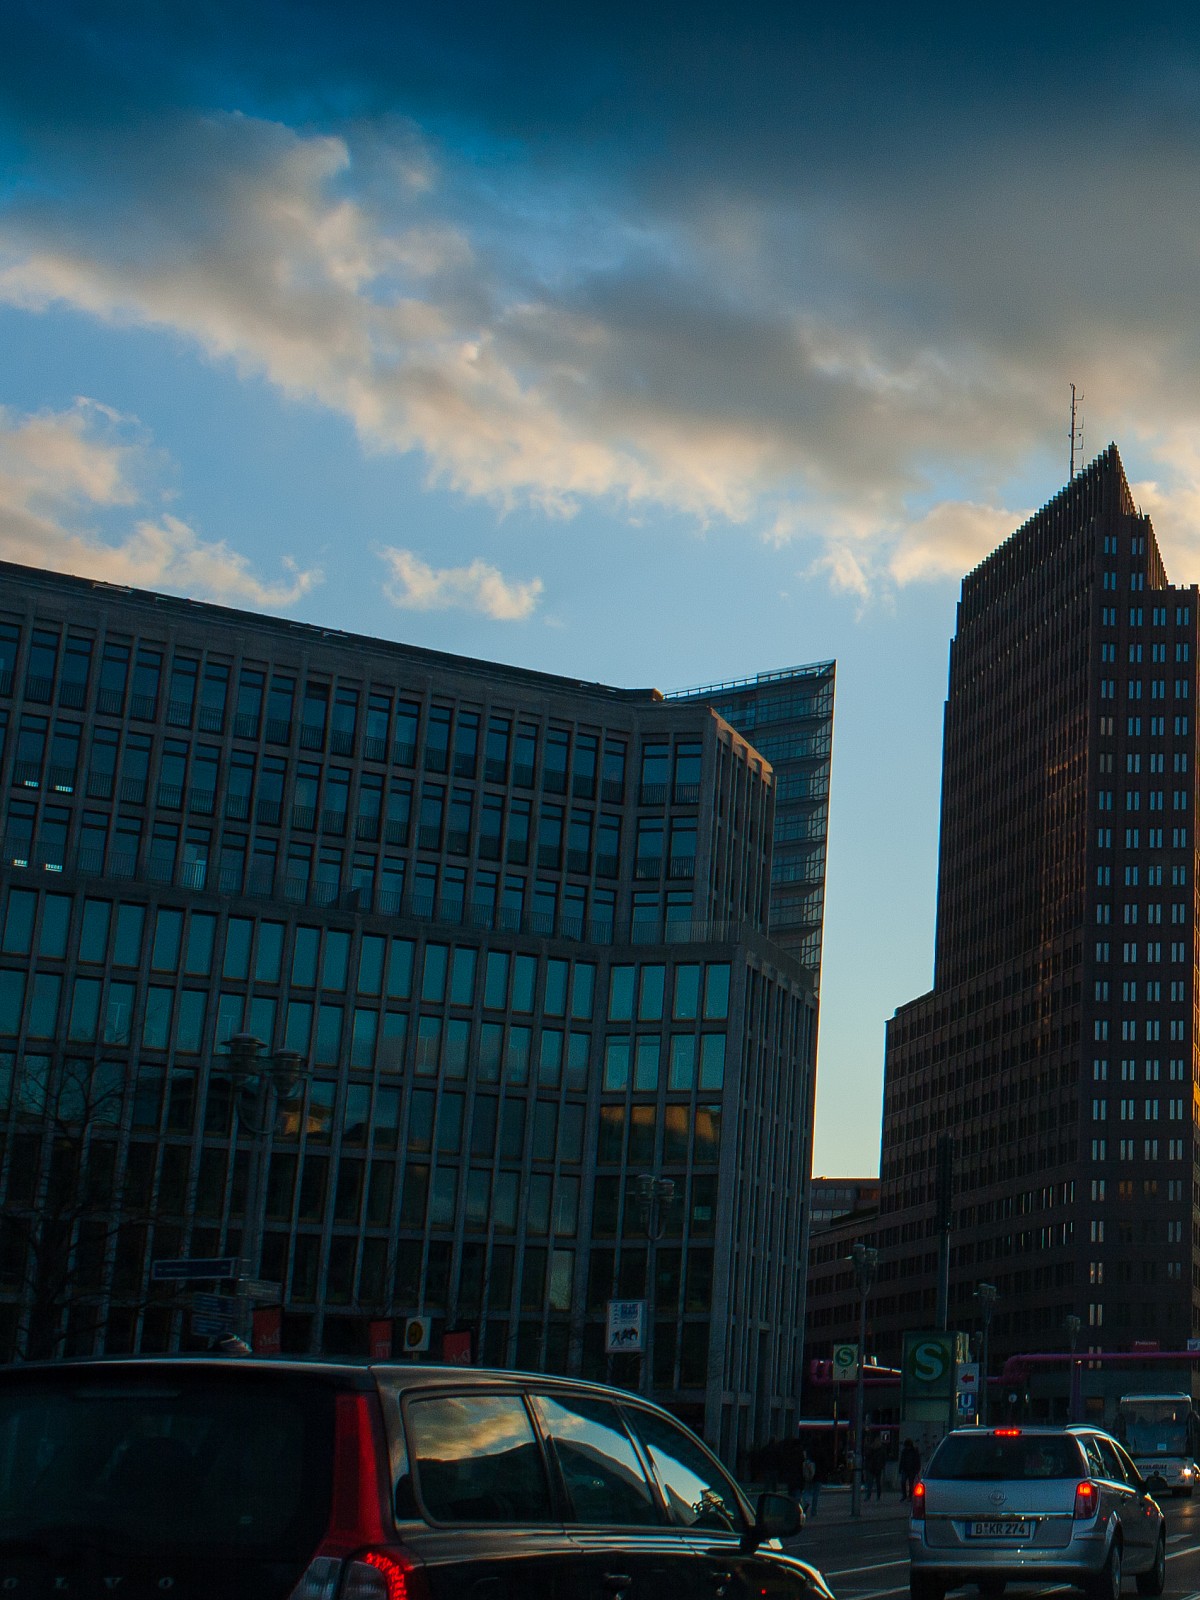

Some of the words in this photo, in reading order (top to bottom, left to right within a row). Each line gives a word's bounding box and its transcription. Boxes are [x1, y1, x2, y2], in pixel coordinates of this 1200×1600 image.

[916, 1343, 944, 1381] S
[961, 1394, 972, 1408] U
[1006, 1522, 1025, 1534] 274
